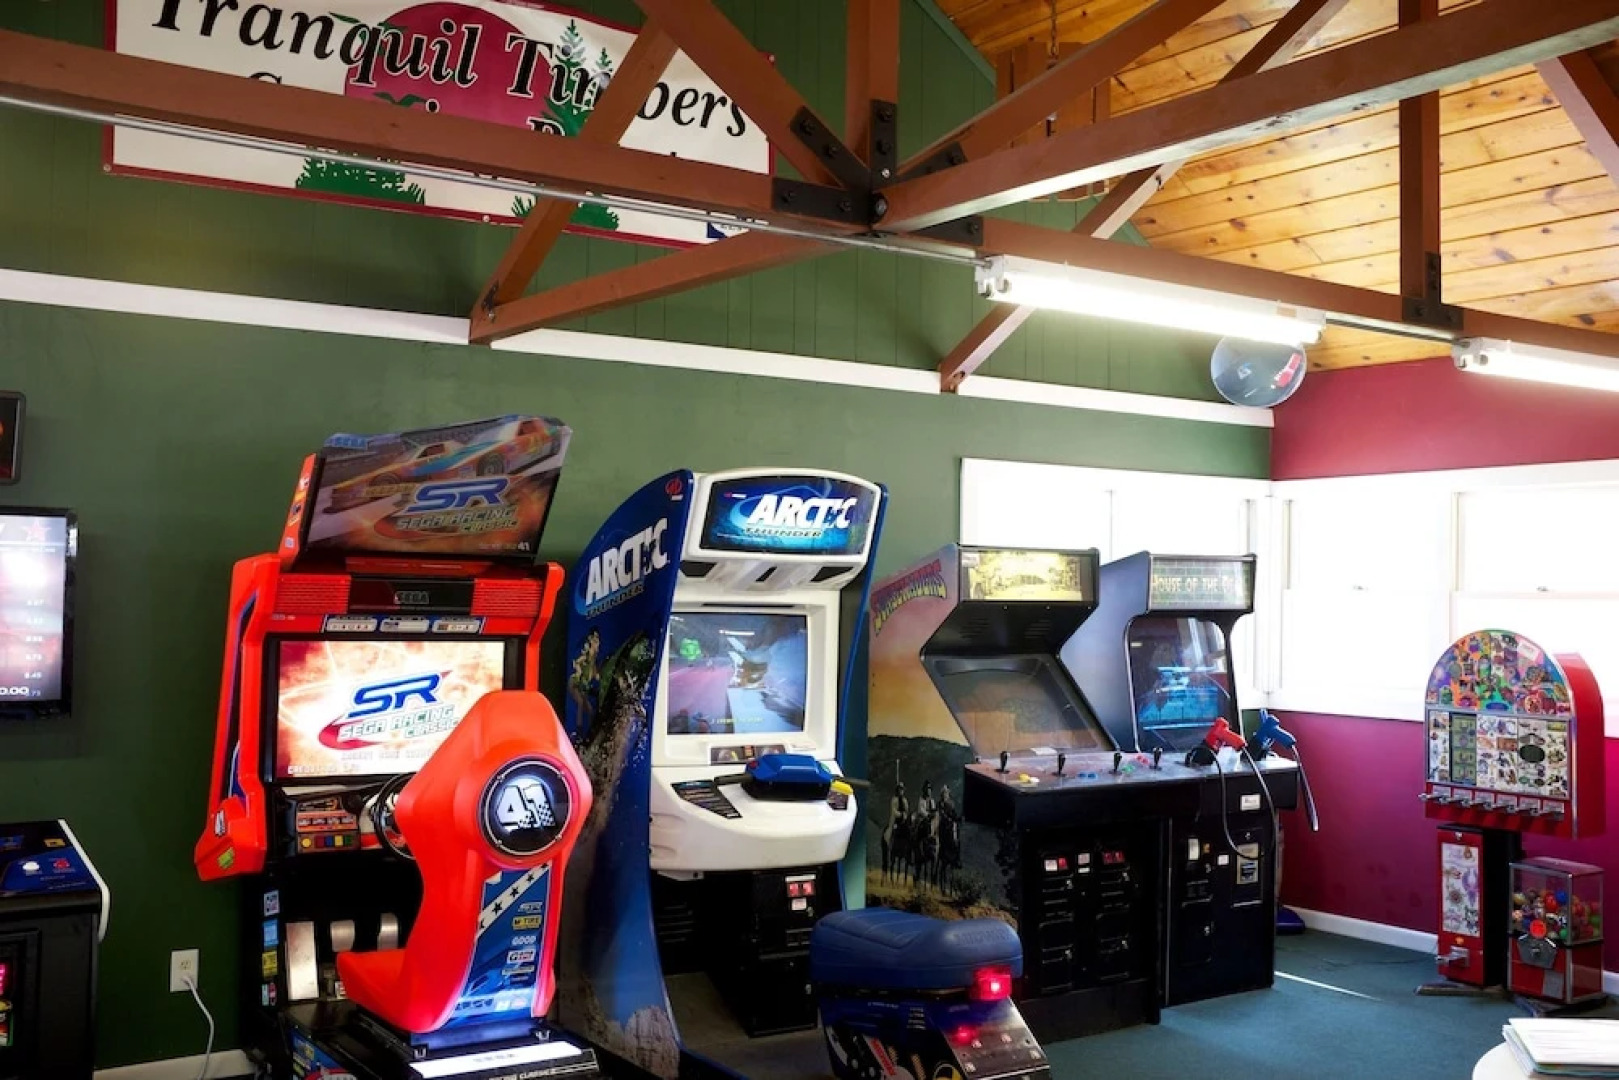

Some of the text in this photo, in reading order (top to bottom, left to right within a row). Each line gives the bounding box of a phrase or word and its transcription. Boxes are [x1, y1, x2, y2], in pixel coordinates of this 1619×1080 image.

[405, 477, 509, 514] SR
[745, 494, 857, 529] ARCTIC
[585, 518, 668, 606] ARCTIC
[347, 673, 440, 719] SR
[340, 704, 456, 738] SEGA RACING
[497, 784, 555, 831] 41
